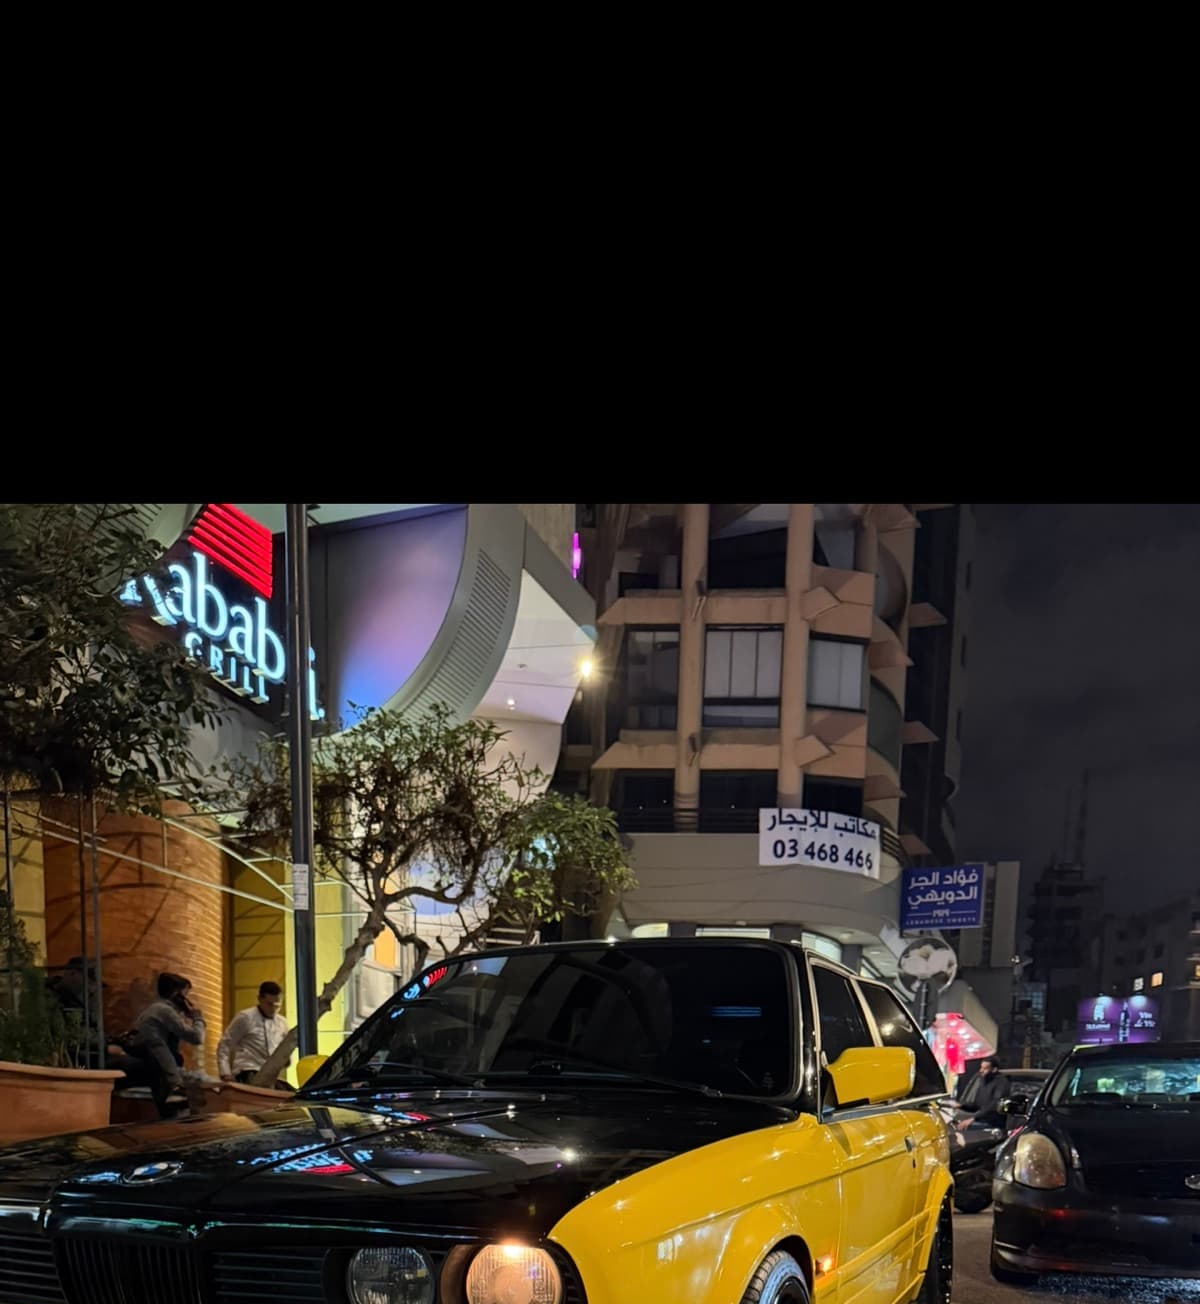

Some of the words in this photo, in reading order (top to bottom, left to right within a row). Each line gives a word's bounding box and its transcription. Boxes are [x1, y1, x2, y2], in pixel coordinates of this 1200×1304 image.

[119, 551, 325, 720] ababi
[773, 839, 798, 858] 03
[804, 841, 839, 863] 468
[844, 848, 873, 870] 466
[943, 868, 979, 887] فؤاد
[907, 885, 979, 910] الدويهي
